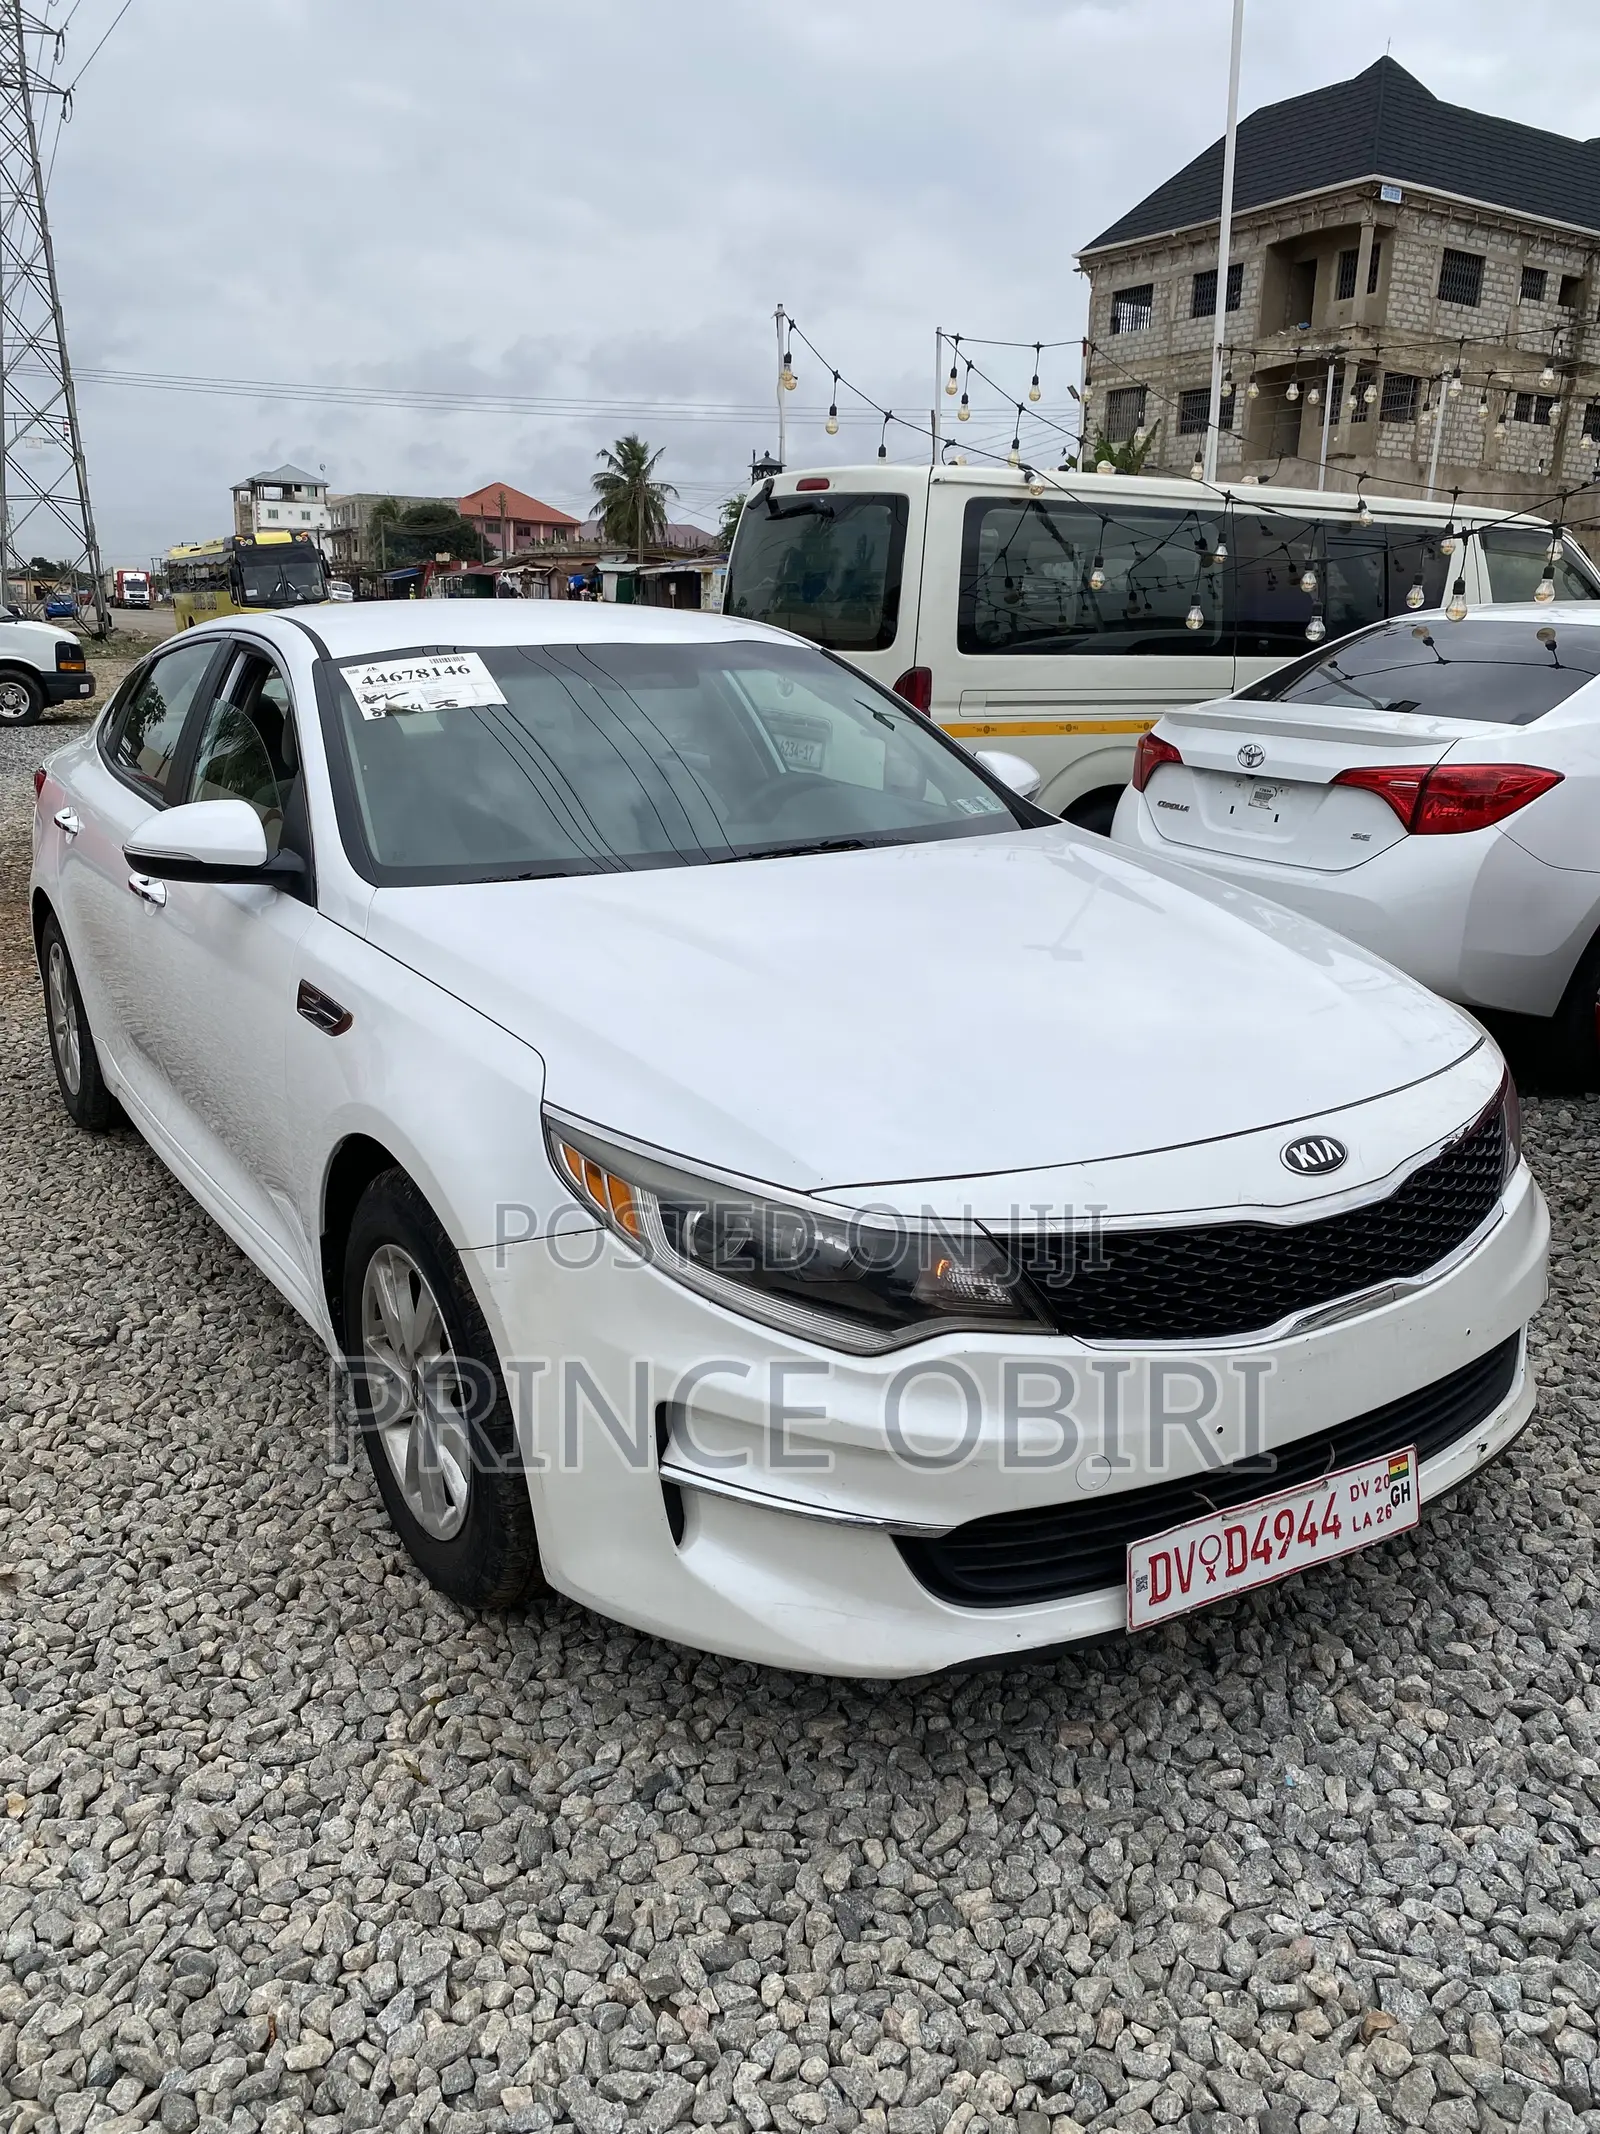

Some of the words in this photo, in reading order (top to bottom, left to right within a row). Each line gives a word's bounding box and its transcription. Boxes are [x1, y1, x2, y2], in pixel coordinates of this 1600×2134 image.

[362, 664, 471, 686] 44678146
[1157, 800, 1190, 812] COROLLA
[1290, 1138, 1343, 1168] KIA
[1350, 1480, 1369, 1502] DV
[1375, 1473, 1390, 1493] 20
[1390, 1481, 1411, 1507] GH
[1353, 1515, 1373, 1532] LA
[1377, 1504, 1392, 1523] 26
